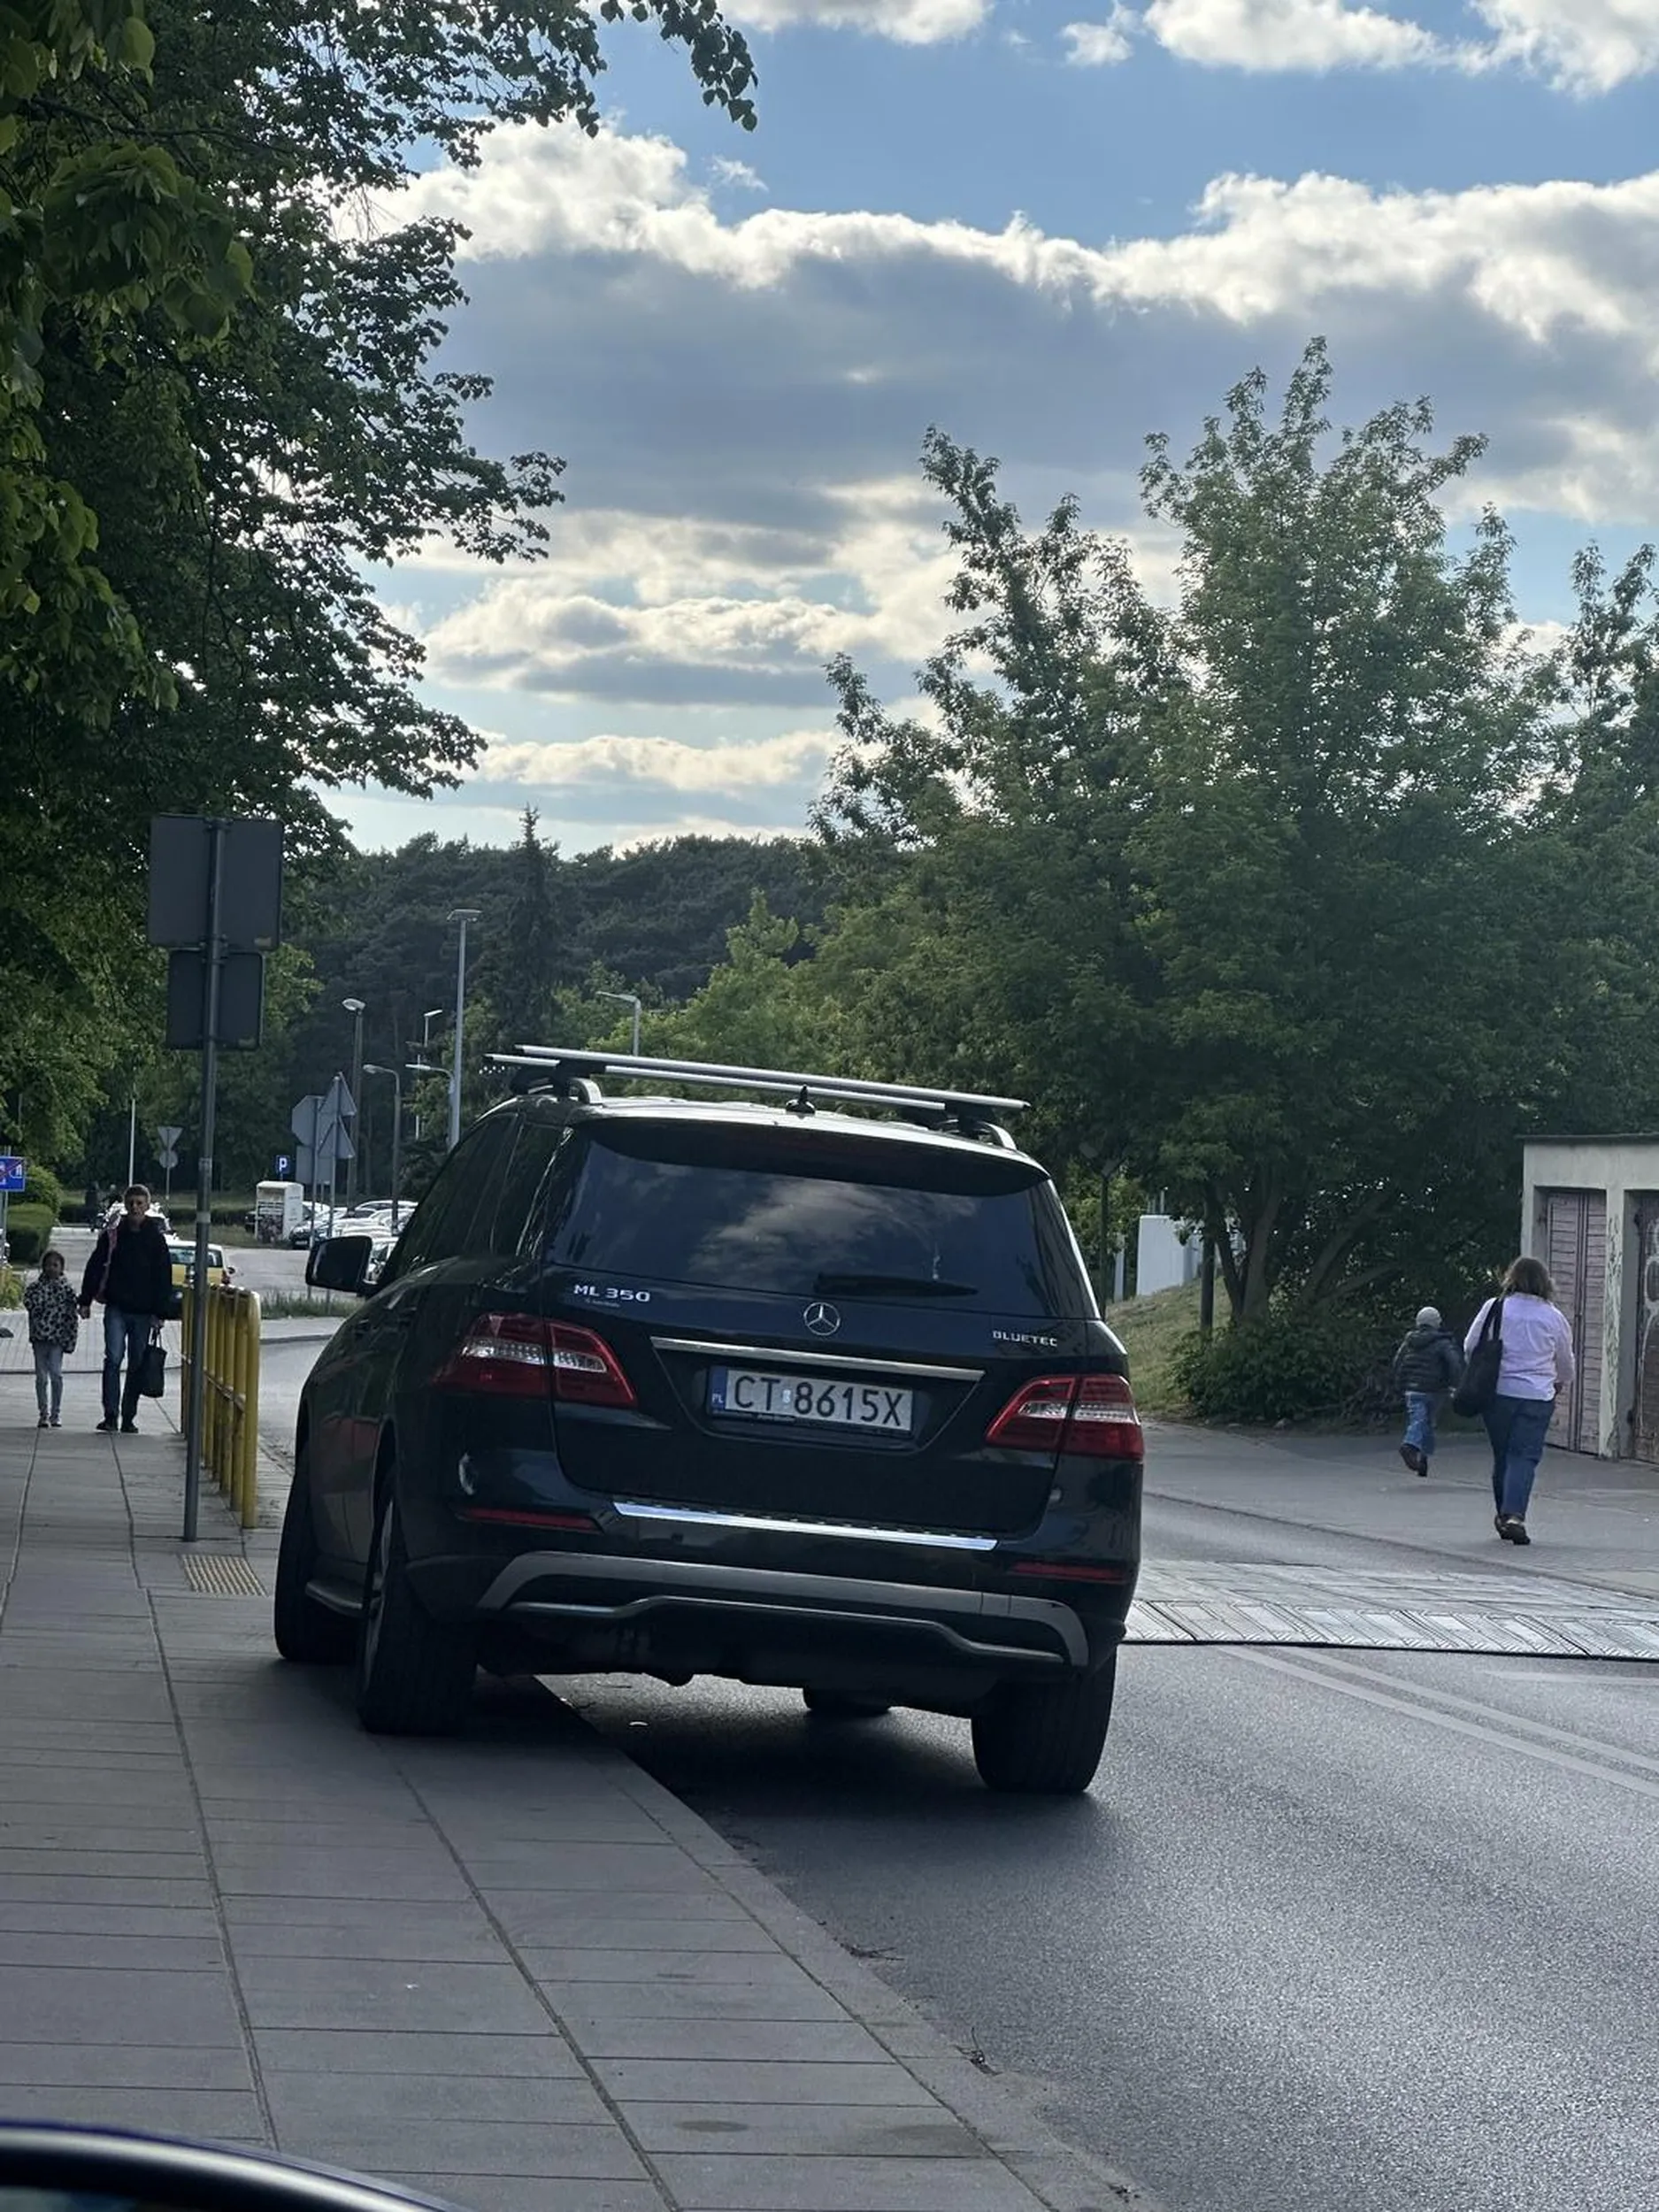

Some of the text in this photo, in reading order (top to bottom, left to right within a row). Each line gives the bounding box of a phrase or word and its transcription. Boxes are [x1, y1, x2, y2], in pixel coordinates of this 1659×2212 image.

[279, 1157, 288, 1171] P
[573, 1285, 651, 1302] ML 350
[992, 1330, 1058, 1347] BLUETEC
[711, 1393, 725, 1404] PL
[734, 1375, 903, 1427] CT 8615X
